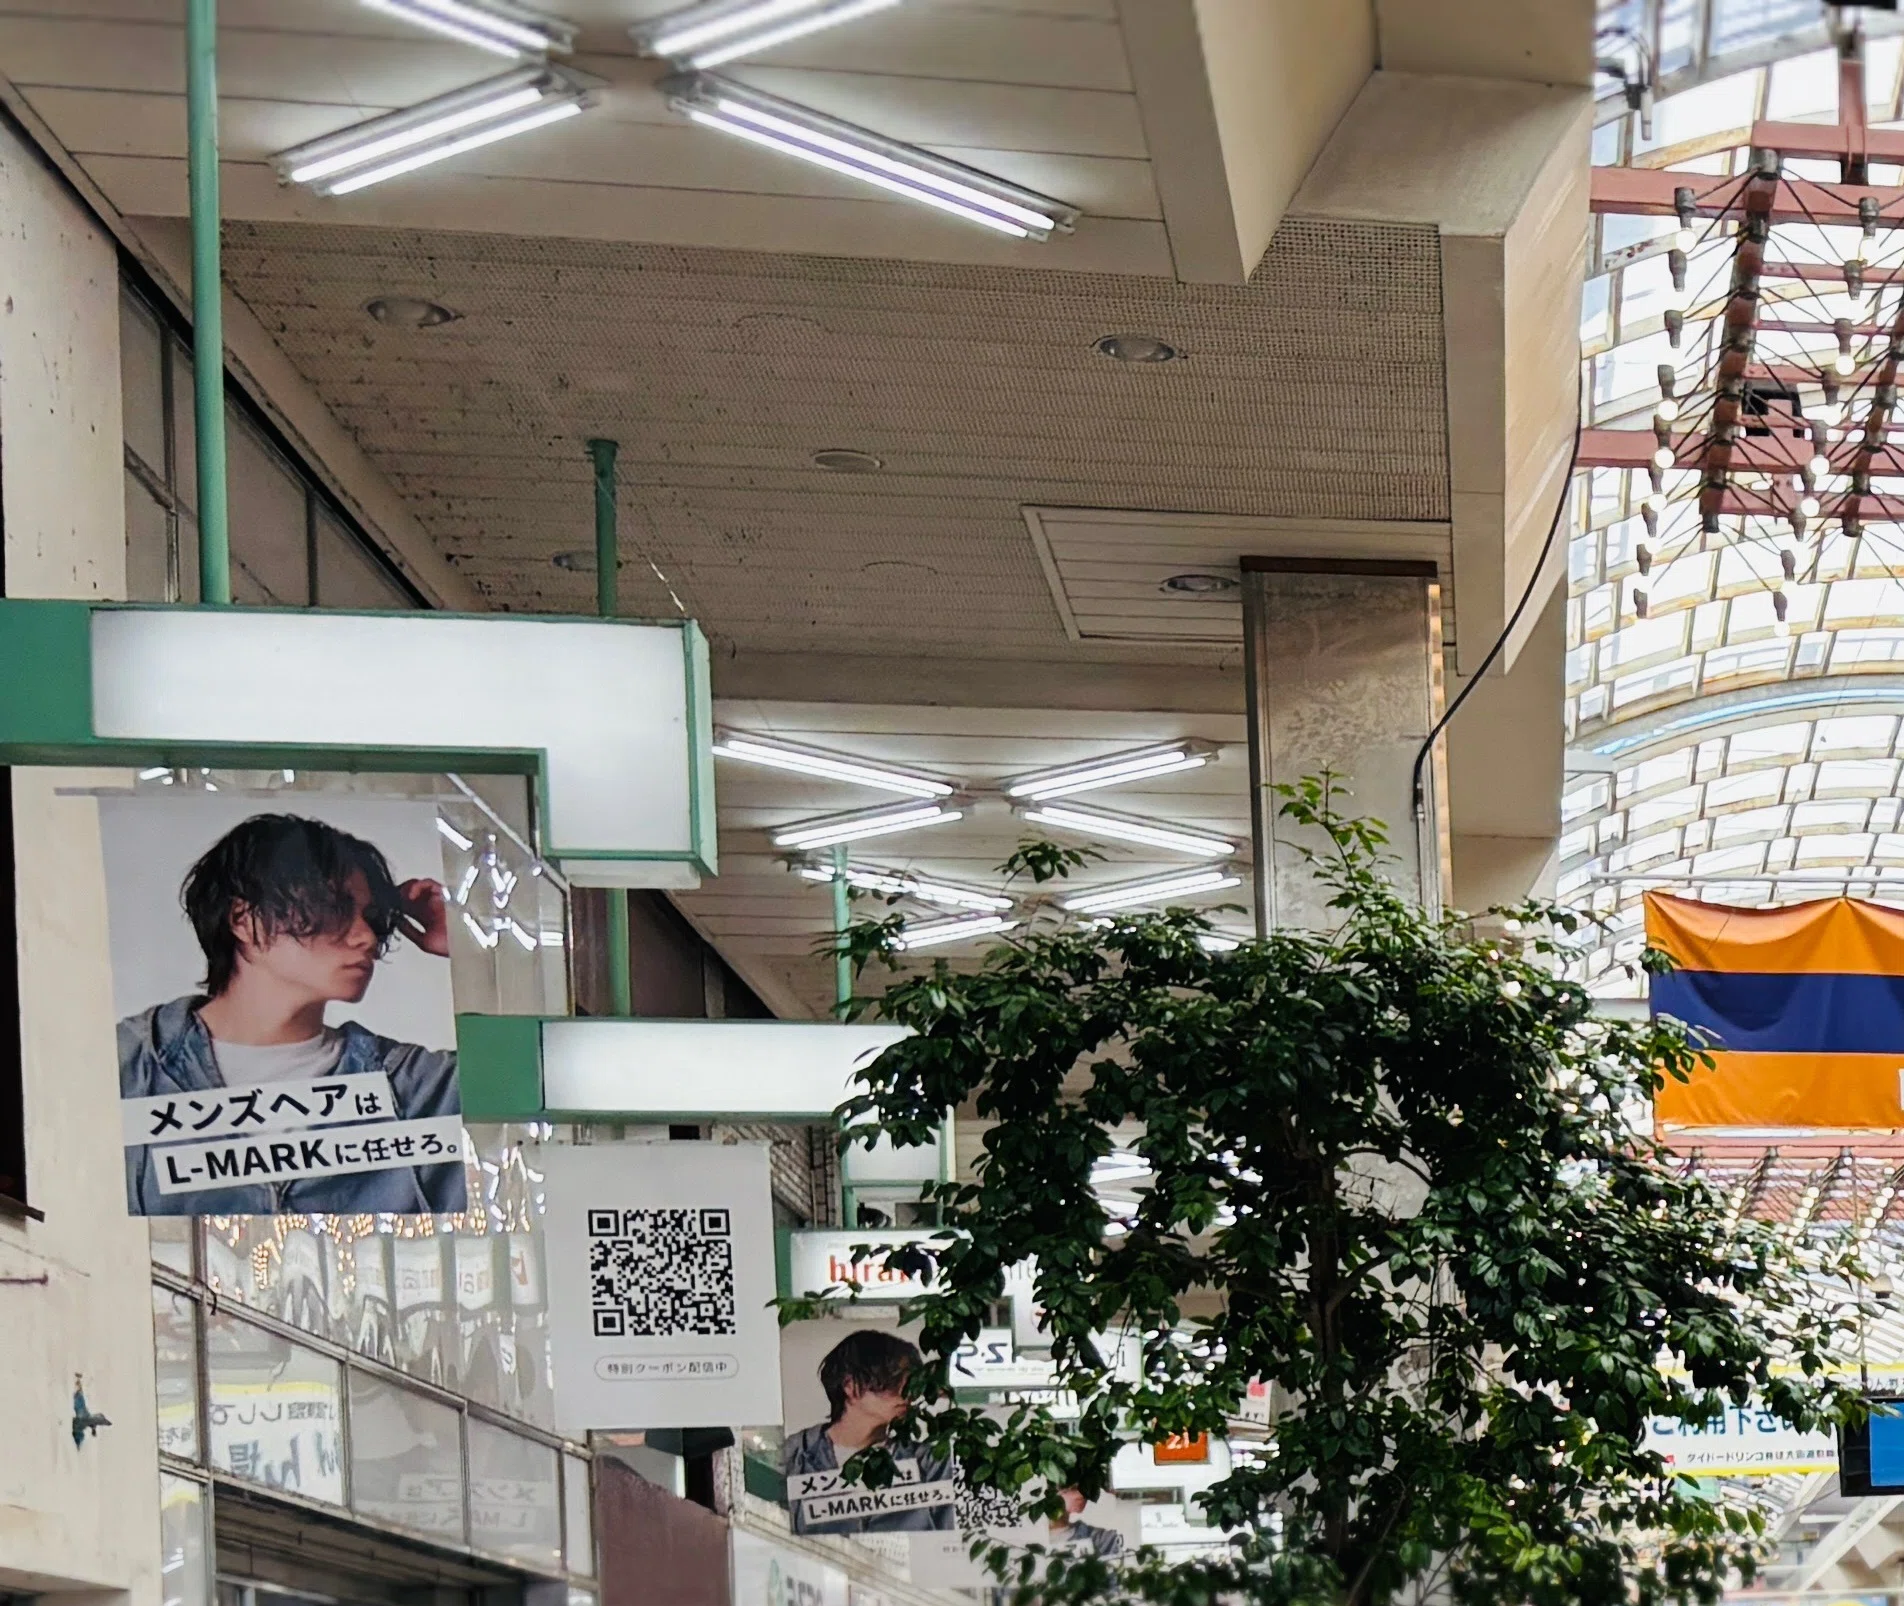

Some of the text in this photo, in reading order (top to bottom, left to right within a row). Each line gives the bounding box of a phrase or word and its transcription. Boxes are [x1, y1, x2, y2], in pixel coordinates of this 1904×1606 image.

[150, 1083, 382, 1136] メンズヘアは
[166, 1133, 457, 1185] L-MARKに任せろ。
[606, 1361, 728, 1375] 特別クーポン配信中
